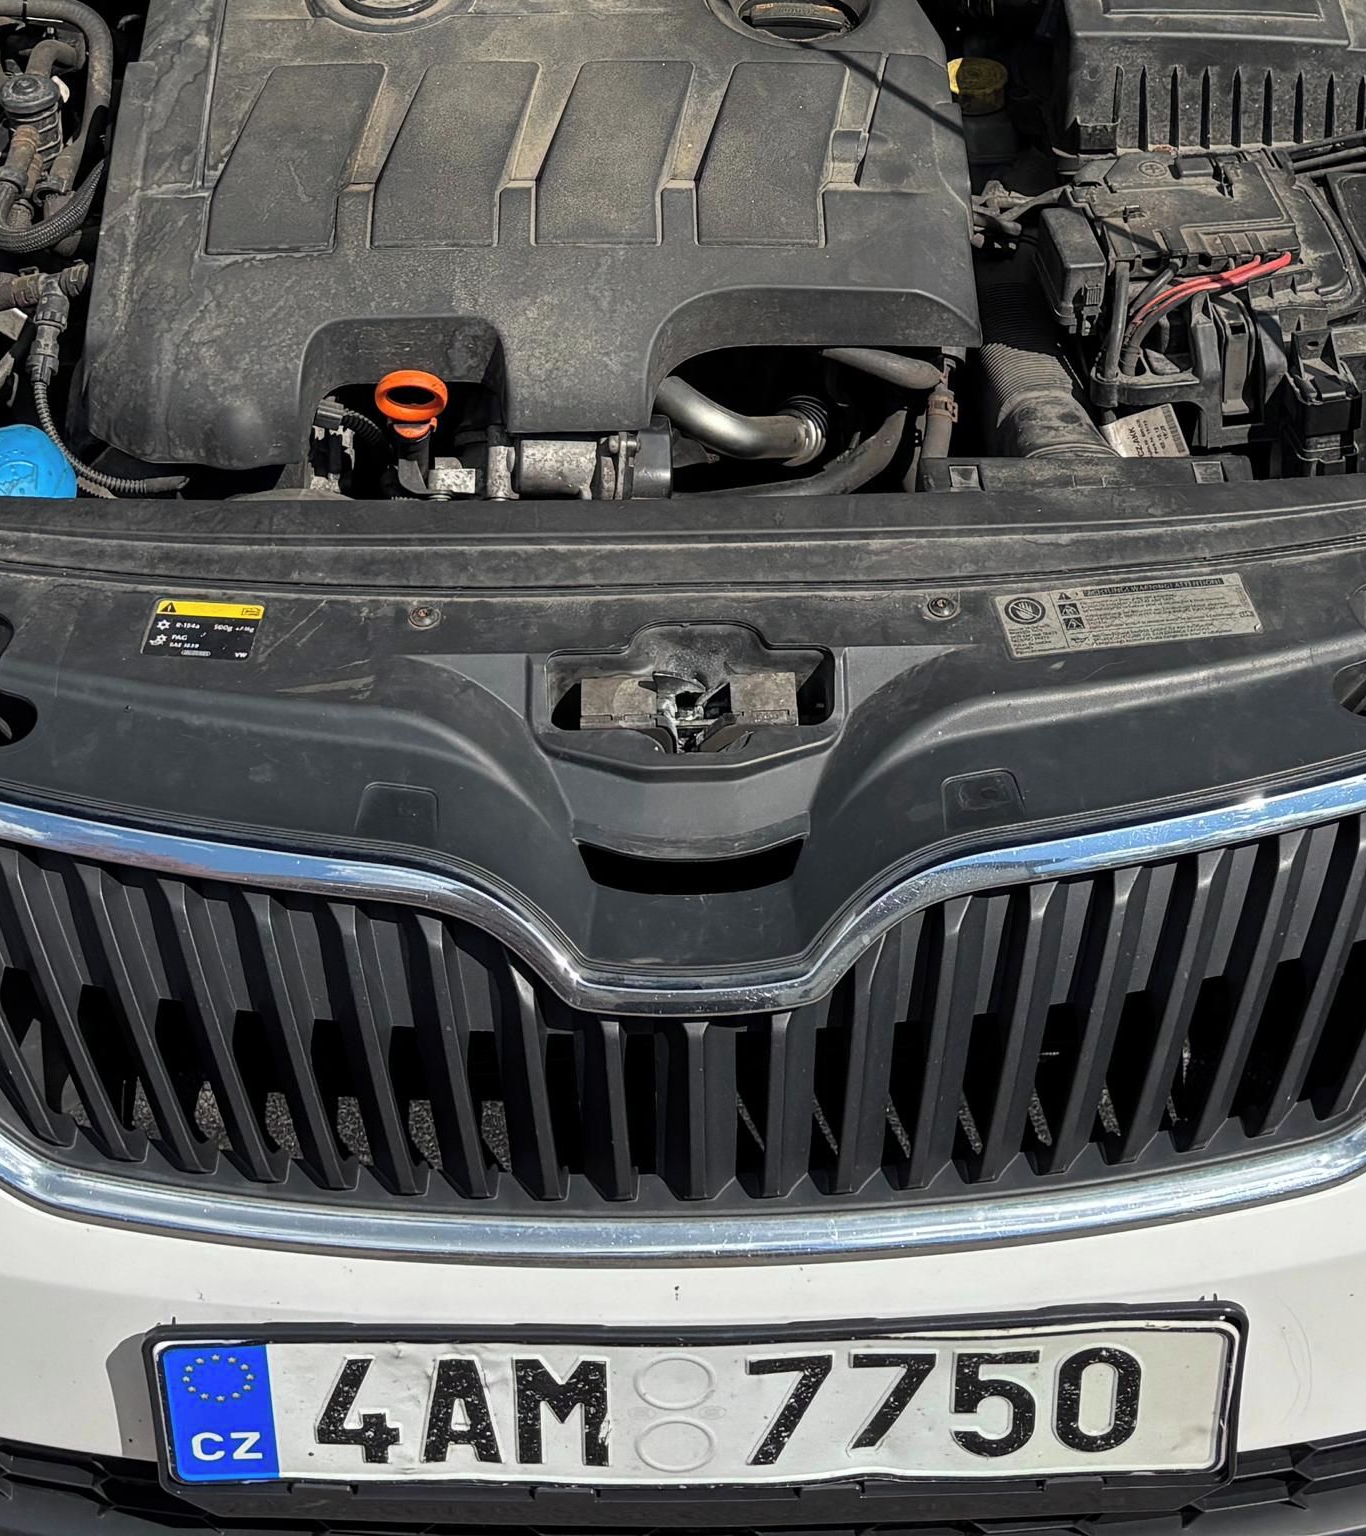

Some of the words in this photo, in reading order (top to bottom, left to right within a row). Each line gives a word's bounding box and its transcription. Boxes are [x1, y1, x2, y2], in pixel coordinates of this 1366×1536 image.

[315, 1356, 611, 1467] 4AM
[745, 1346, 1143, 1466] 7750
[191, 1431, 263, 1461] CZ
